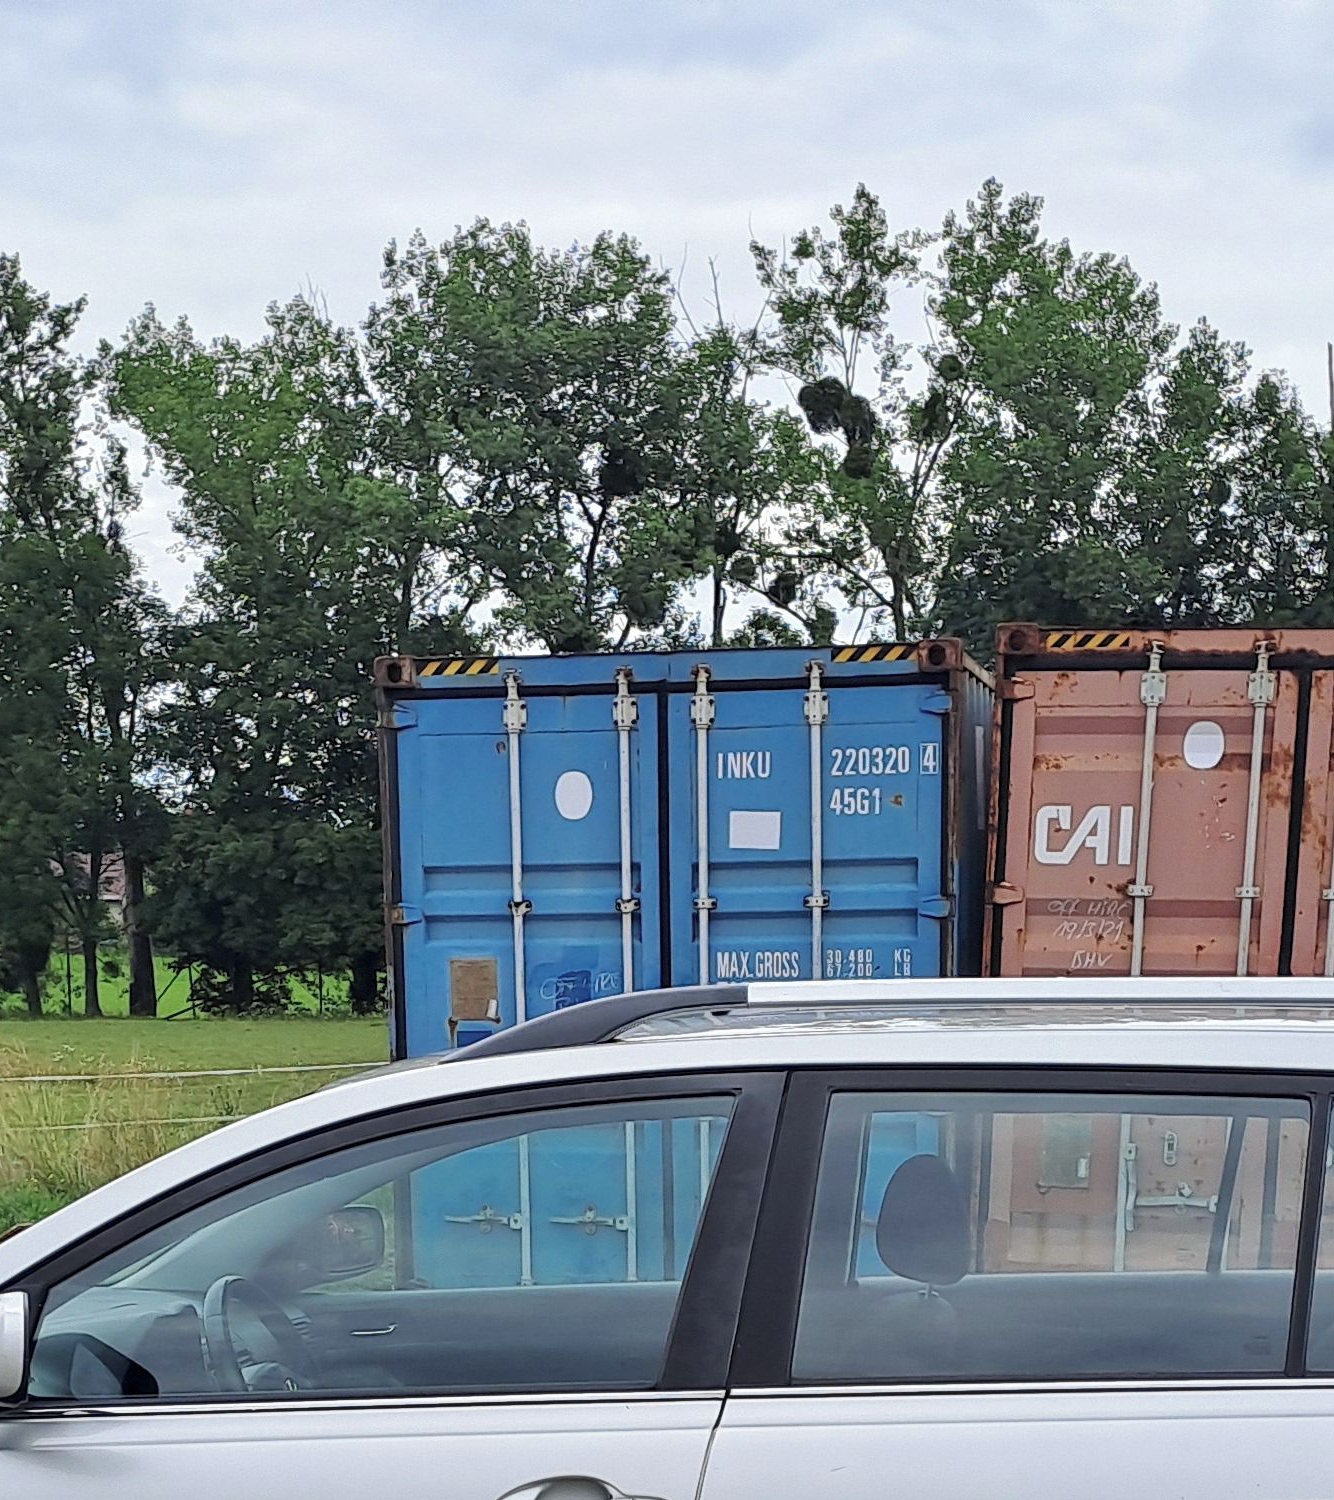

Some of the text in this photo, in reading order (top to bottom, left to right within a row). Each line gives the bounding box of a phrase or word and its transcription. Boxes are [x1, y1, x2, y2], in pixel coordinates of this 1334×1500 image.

[717, 744, 937, 779] INKU 220320 4
[829, 787, 882, 815] 45G1
[1034, 805, 1134, 865] CAI
[894, 948, 911, 963] KG
[894, 962, 911, 976] LB
